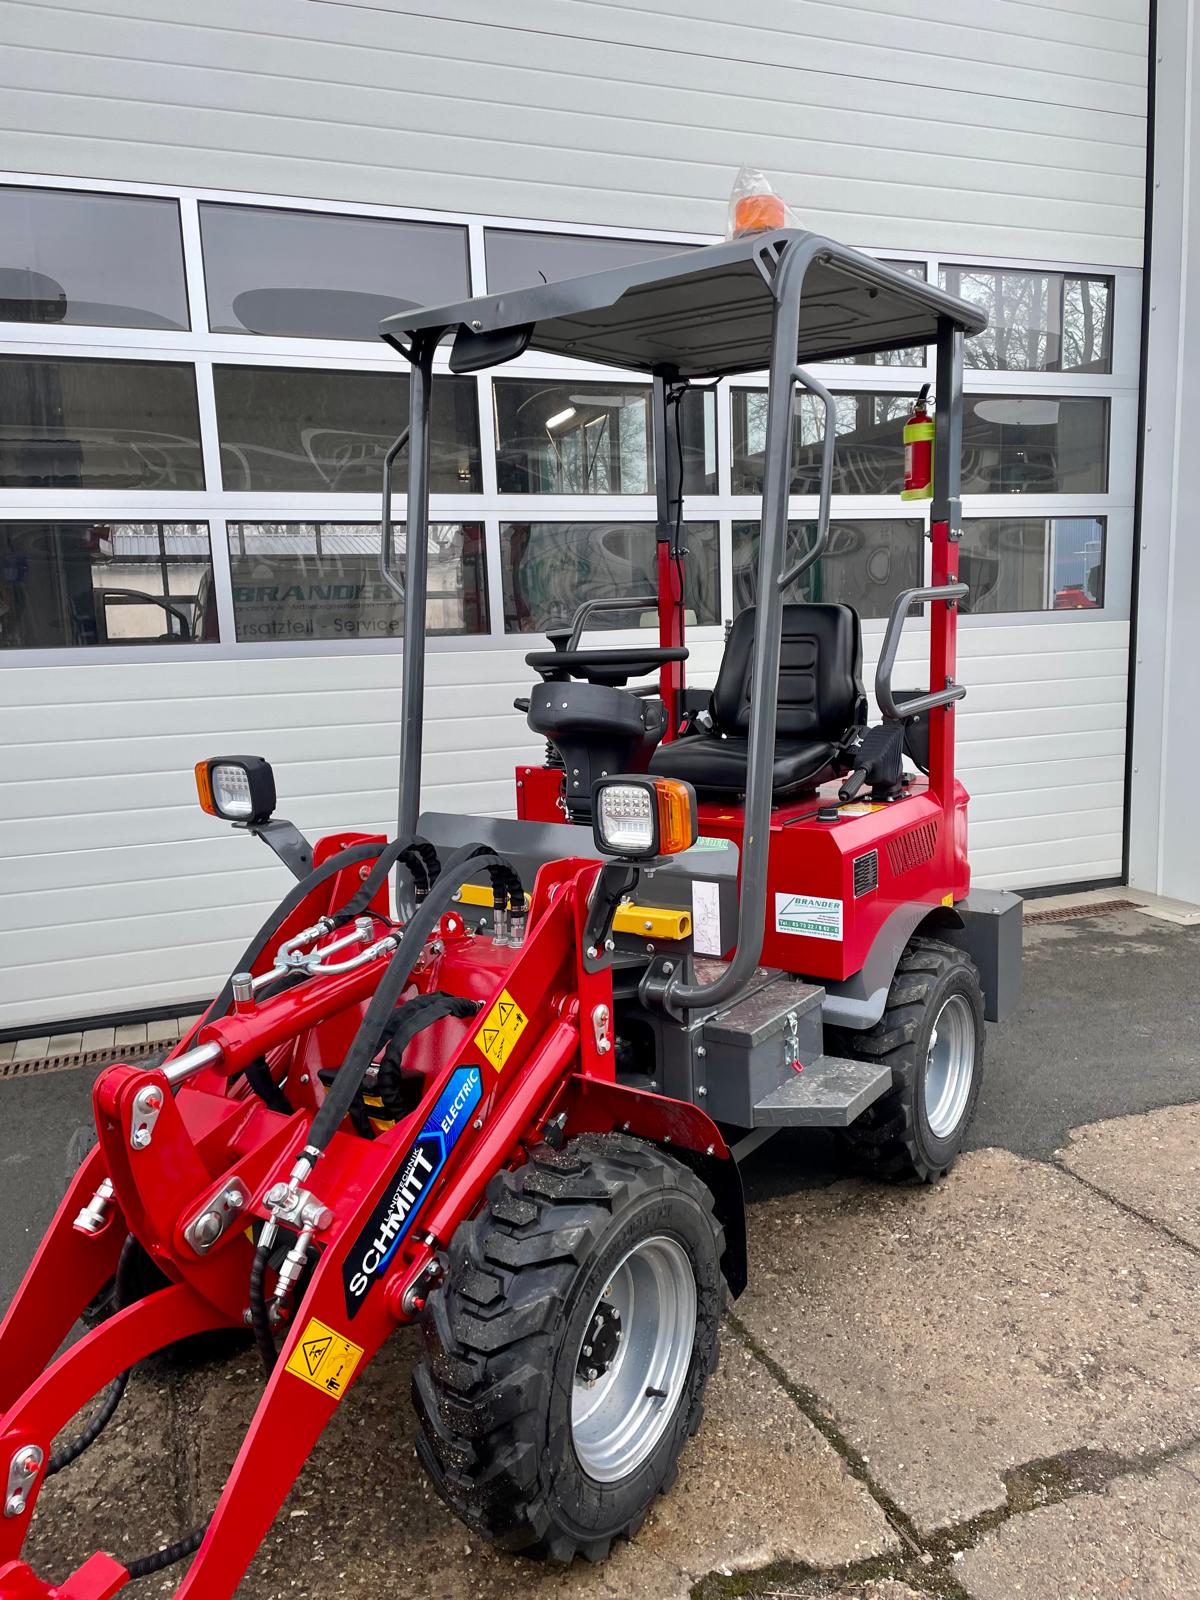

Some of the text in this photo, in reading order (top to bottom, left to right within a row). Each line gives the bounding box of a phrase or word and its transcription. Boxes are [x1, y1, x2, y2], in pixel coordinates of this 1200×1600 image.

[232, 584, 393, 603] BRANDER
[334, 618, 399, 636] Service
[794, 897, 840, 909] BRANDER
[441, 1069, 479, 1134] ELECTRIC
[384, 1148, 420, 1222] LANDTECHNIK
[349, 1147, 433, 1297] SCHMITT
